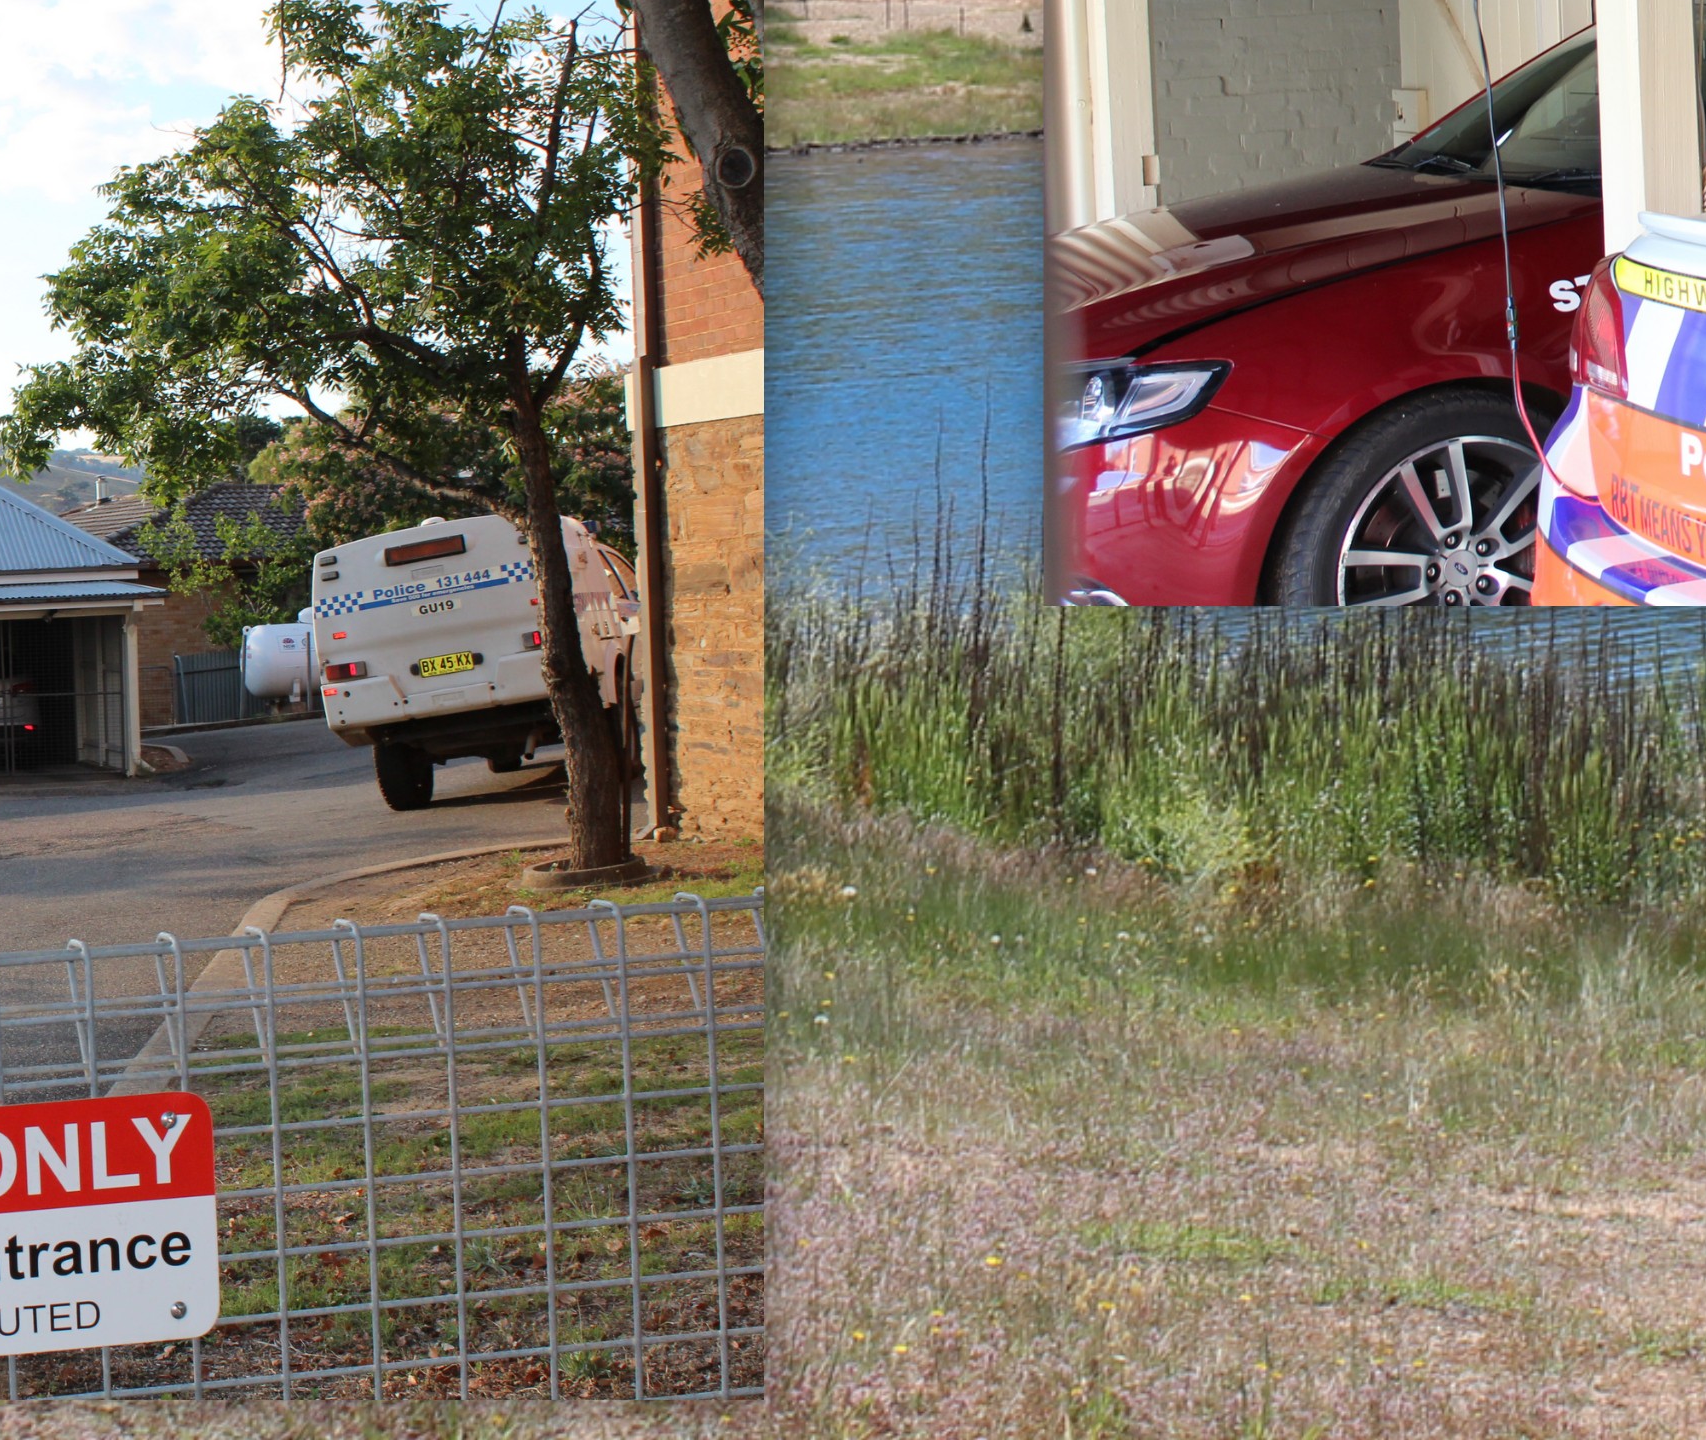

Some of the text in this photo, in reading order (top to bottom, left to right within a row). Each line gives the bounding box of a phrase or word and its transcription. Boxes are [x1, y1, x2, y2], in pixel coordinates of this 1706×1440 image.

[1611, 474, 1638, 530] RBT
[1640, 496, 1692, 554] MEANS
[372, 569, 491, 600] Police 131 444
[419, 599, 455, 615] GU19
[422, 659, 437, 673] BX
[440, 656, 454, 669] 45
[456, 653, 471, 666] KX
